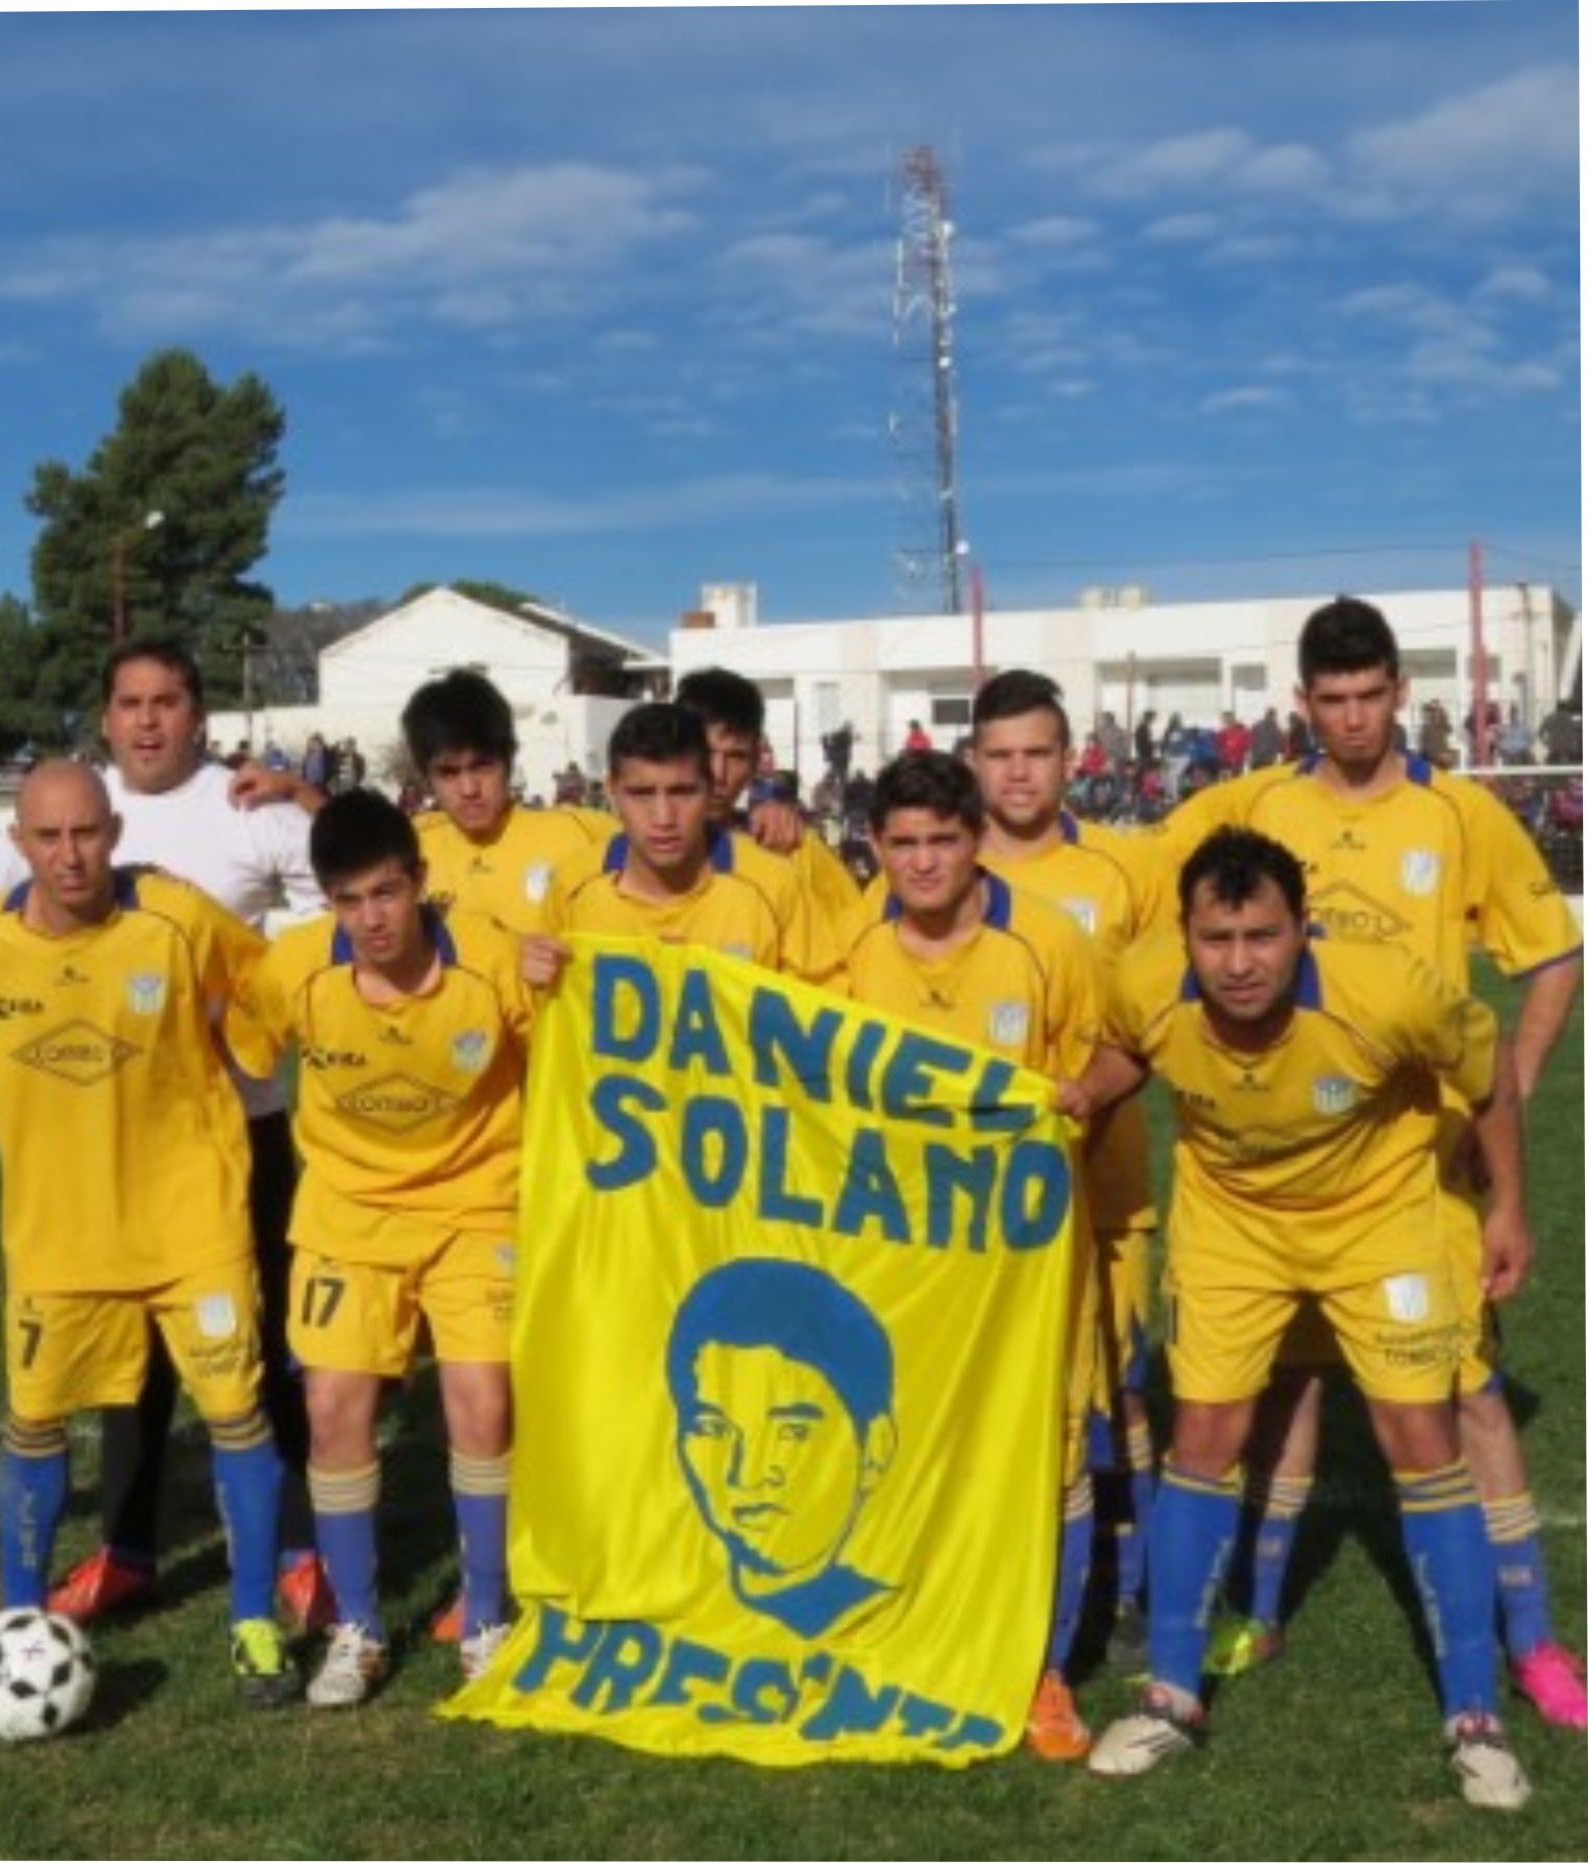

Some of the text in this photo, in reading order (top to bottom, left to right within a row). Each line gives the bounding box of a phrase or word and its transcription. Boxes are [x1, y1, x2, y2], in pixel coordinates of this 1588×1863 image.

[592, 954, 1035, 1133] DANIEL
[586, 1073, 1071, 1252] SOLANO
[19, 1317, 42, 1370] 7
[302, 1276, 345, 1329] 17
